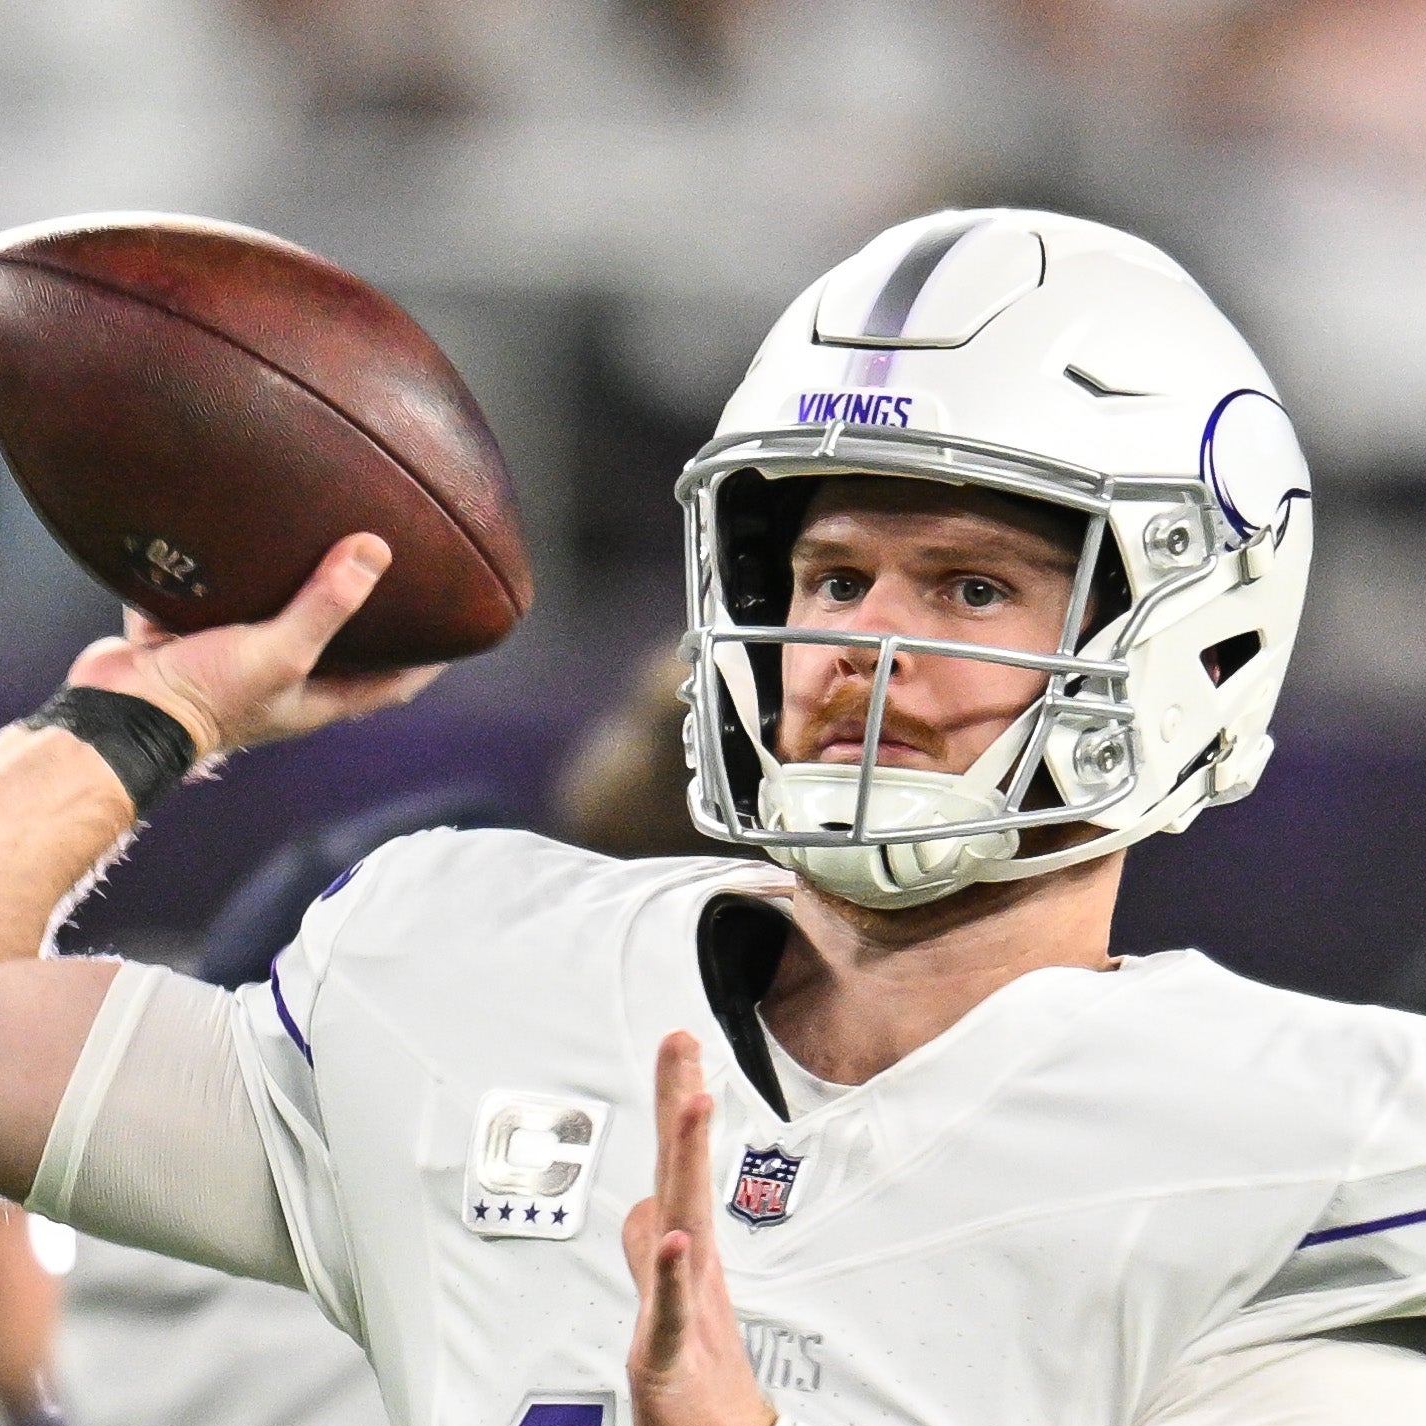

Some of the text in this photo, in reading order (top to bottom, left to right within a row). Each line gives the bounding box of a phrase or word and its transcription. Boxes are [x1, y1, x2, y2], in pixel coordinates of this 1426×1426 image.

[797, 393, 913, 428] VIKINGS
[475, 1107, 594, 1197] C
[735, 1176, 783, 1214] NFL
